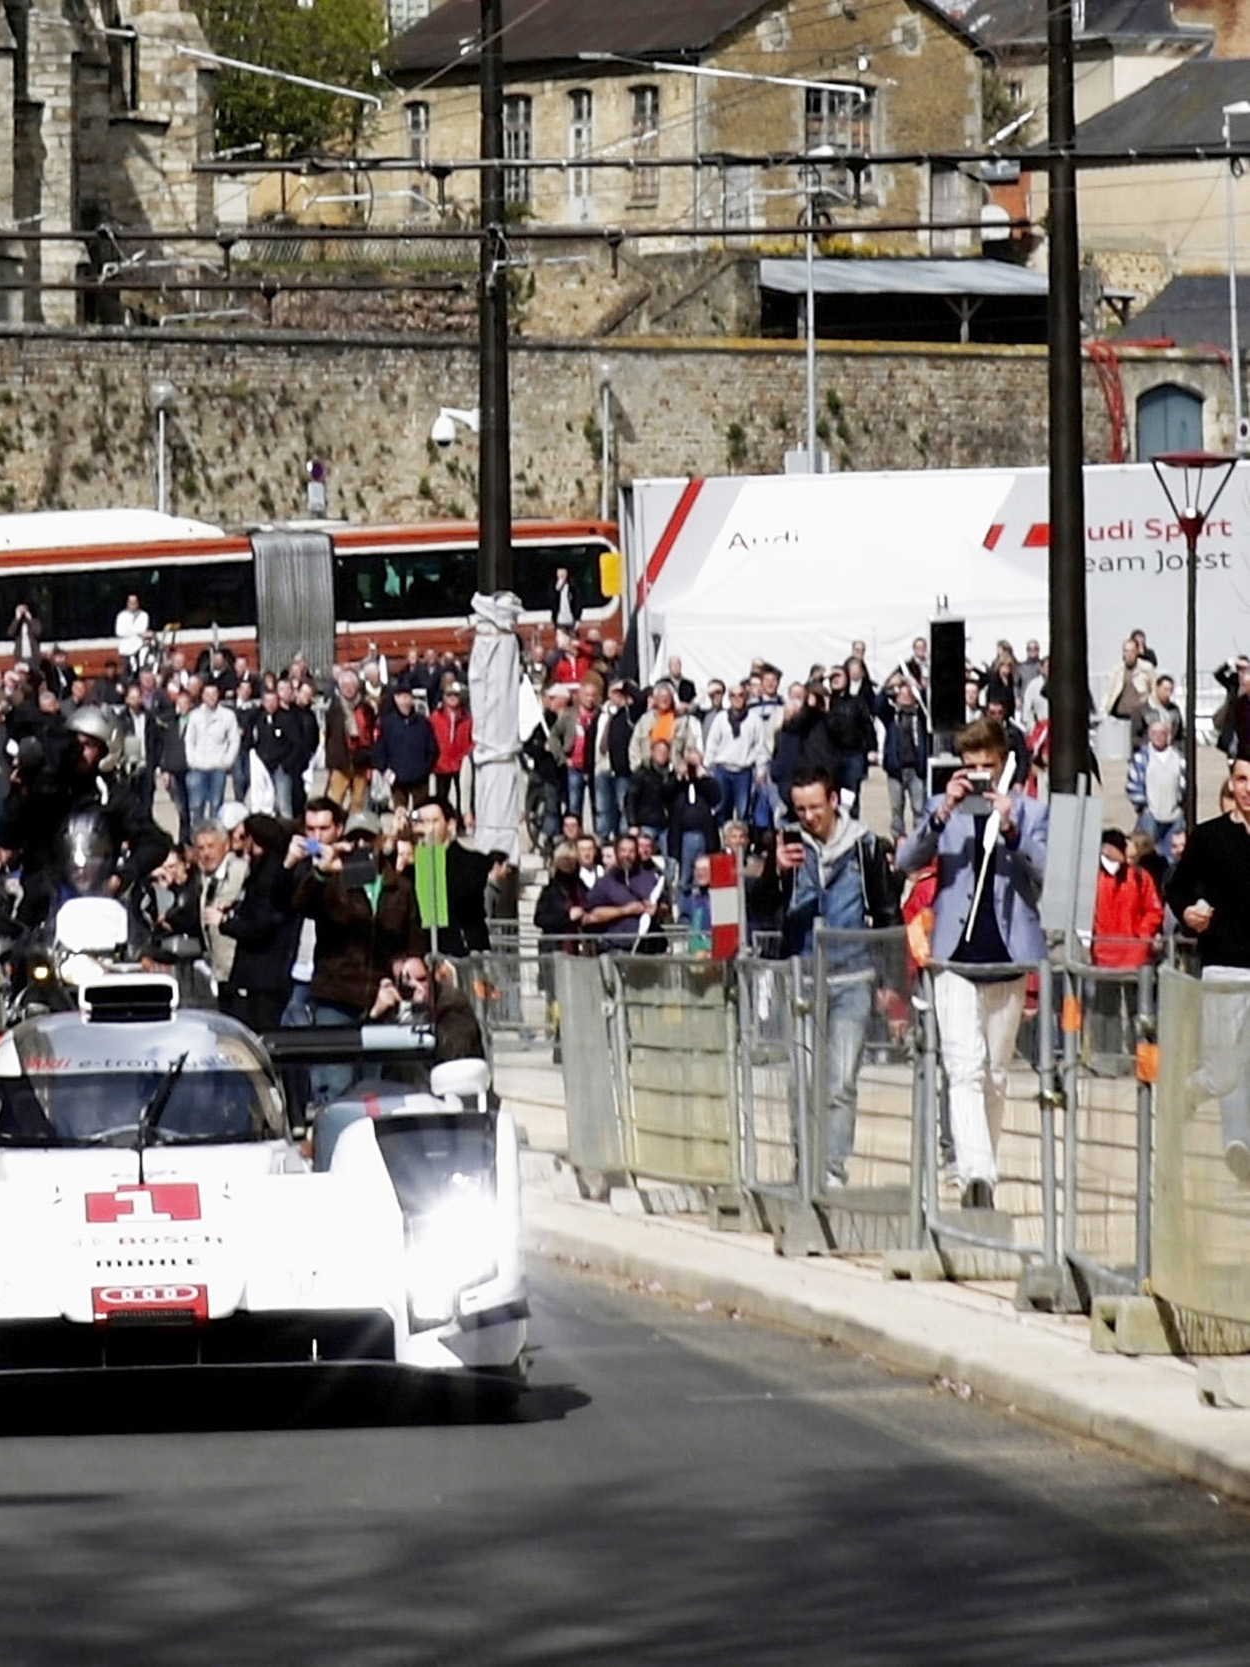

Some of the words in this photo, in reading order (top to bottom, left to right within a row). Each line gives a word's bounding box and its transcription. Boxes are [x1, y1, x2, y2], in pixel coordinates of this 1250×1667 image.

[1087, 519, 1133, 541] udi
[1144, 517, 1233, 543] Sprt
[1085, 555, 1145, 573] eam
[114, 1190, 172, 1223] 1
